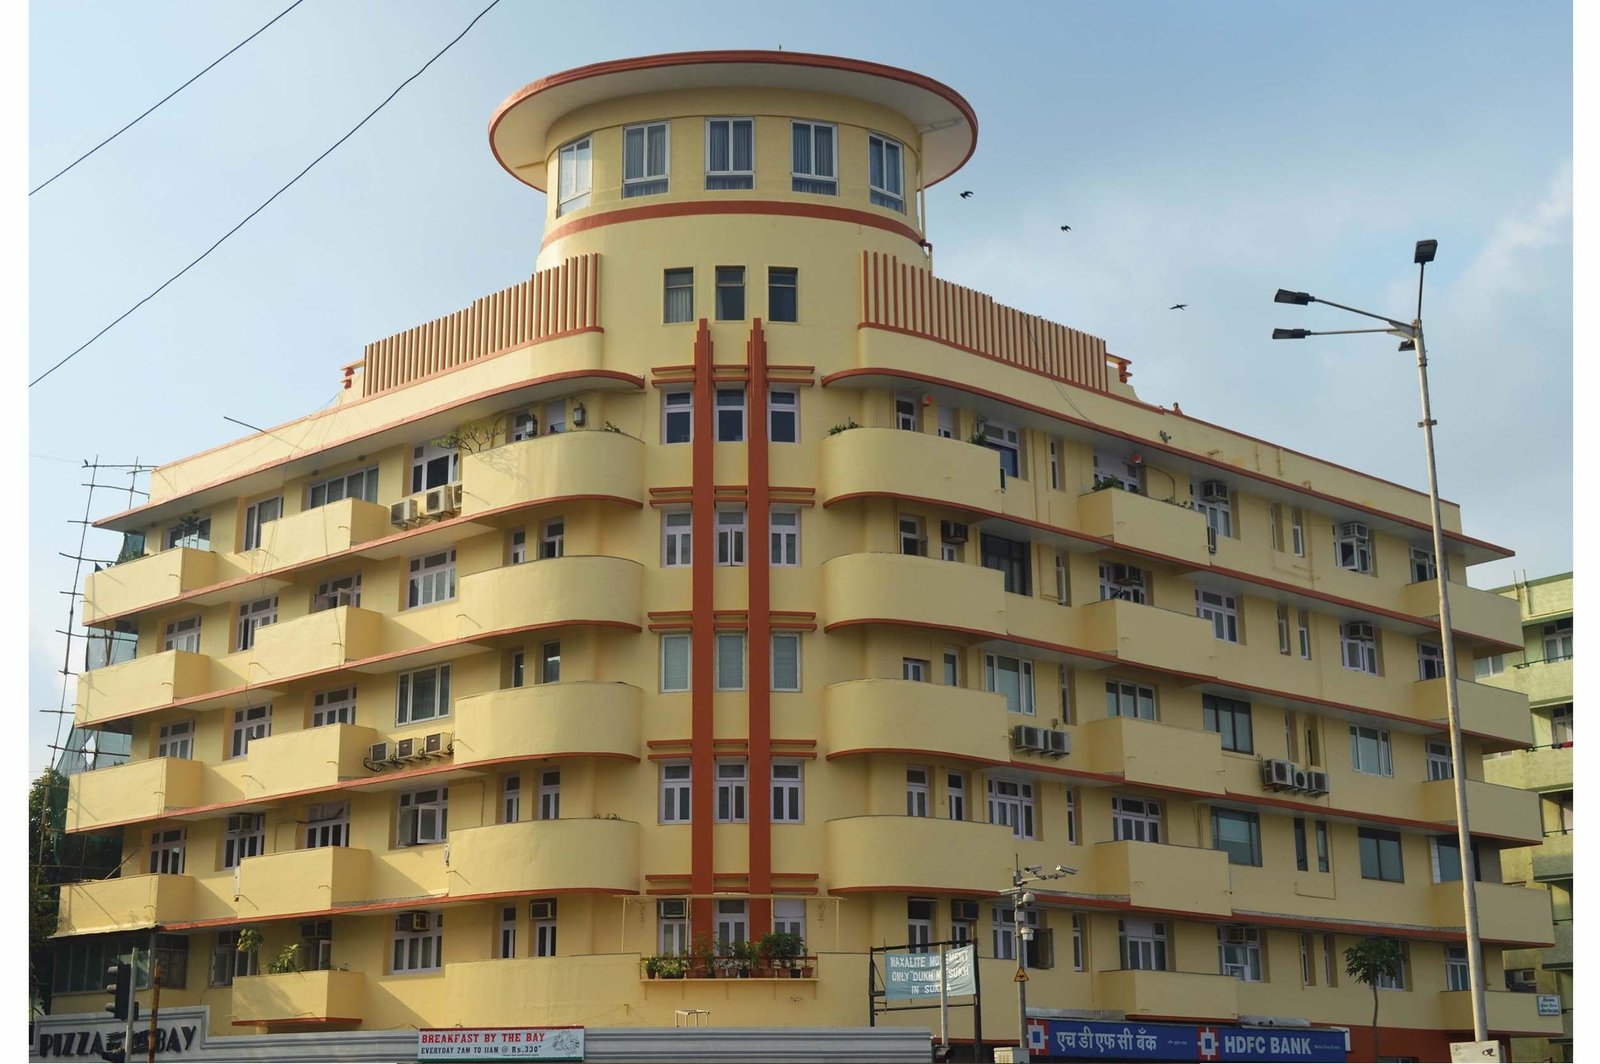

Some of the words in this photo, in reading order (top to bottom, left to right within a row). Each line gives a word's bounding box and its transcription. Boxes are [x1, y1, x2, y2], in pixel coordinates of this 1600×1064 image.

[890, 957, 926, 968] NAXALITE
[929, 951, 969, 967] MOEMENT
[892, 971, 909, 982] ONLY
[911, 985, 919, 995] IN
[924, 983, 951, 994] SUKA
[39, 1031, 104, 1057] PIZZA
[156, 1026, 197, 1053] BAY
[421, 1033, 479, 1043] BREAKFAST
[484, 1033, 496, 1042] BY
[502, 1033, 521, 1042] THE
[526, 1032, 545, 1042] BAY
[1056, 1031, 1077, 1052] एच
[1078, 1026, 1094, 1049] डी
[1095, 1033, 1115, 1053] एफ
[1117, 1028, 1133, 1050] सी
[473, 1046, 481, 1054] TO
[1224, 1036, 1265, 1054] HDFC
[1270, 1037, 1312, 1055] BANK
